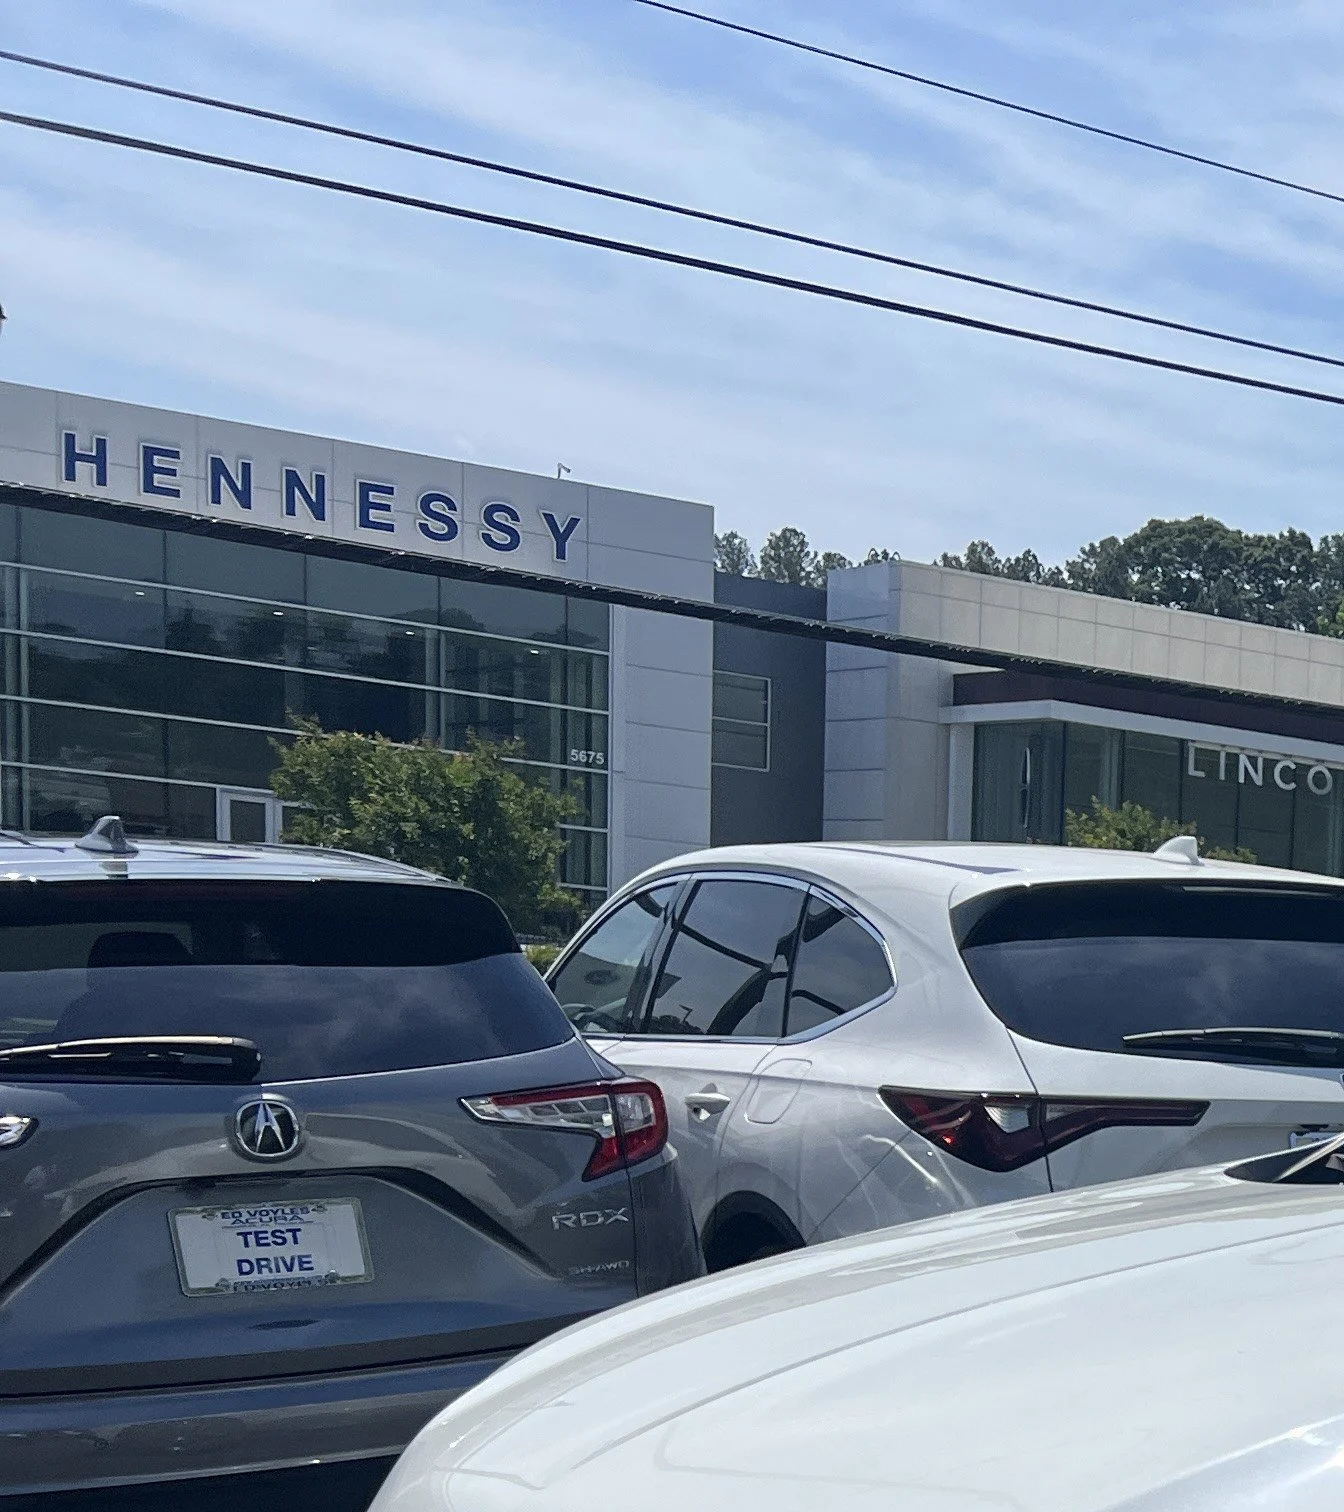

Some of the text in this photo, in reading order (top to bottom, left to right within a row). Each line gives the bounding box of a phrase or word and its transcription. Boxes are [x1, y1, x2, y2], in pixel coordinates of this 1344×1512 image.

[62, 431, 583, 563] HENNESSY
[570, 748, 605, 765] 5675
[552, 1207, 629, 1230] RDX
[236, 1228, 302, 1248] TEST
[236, 1254, 314, 1276] DRIVE
